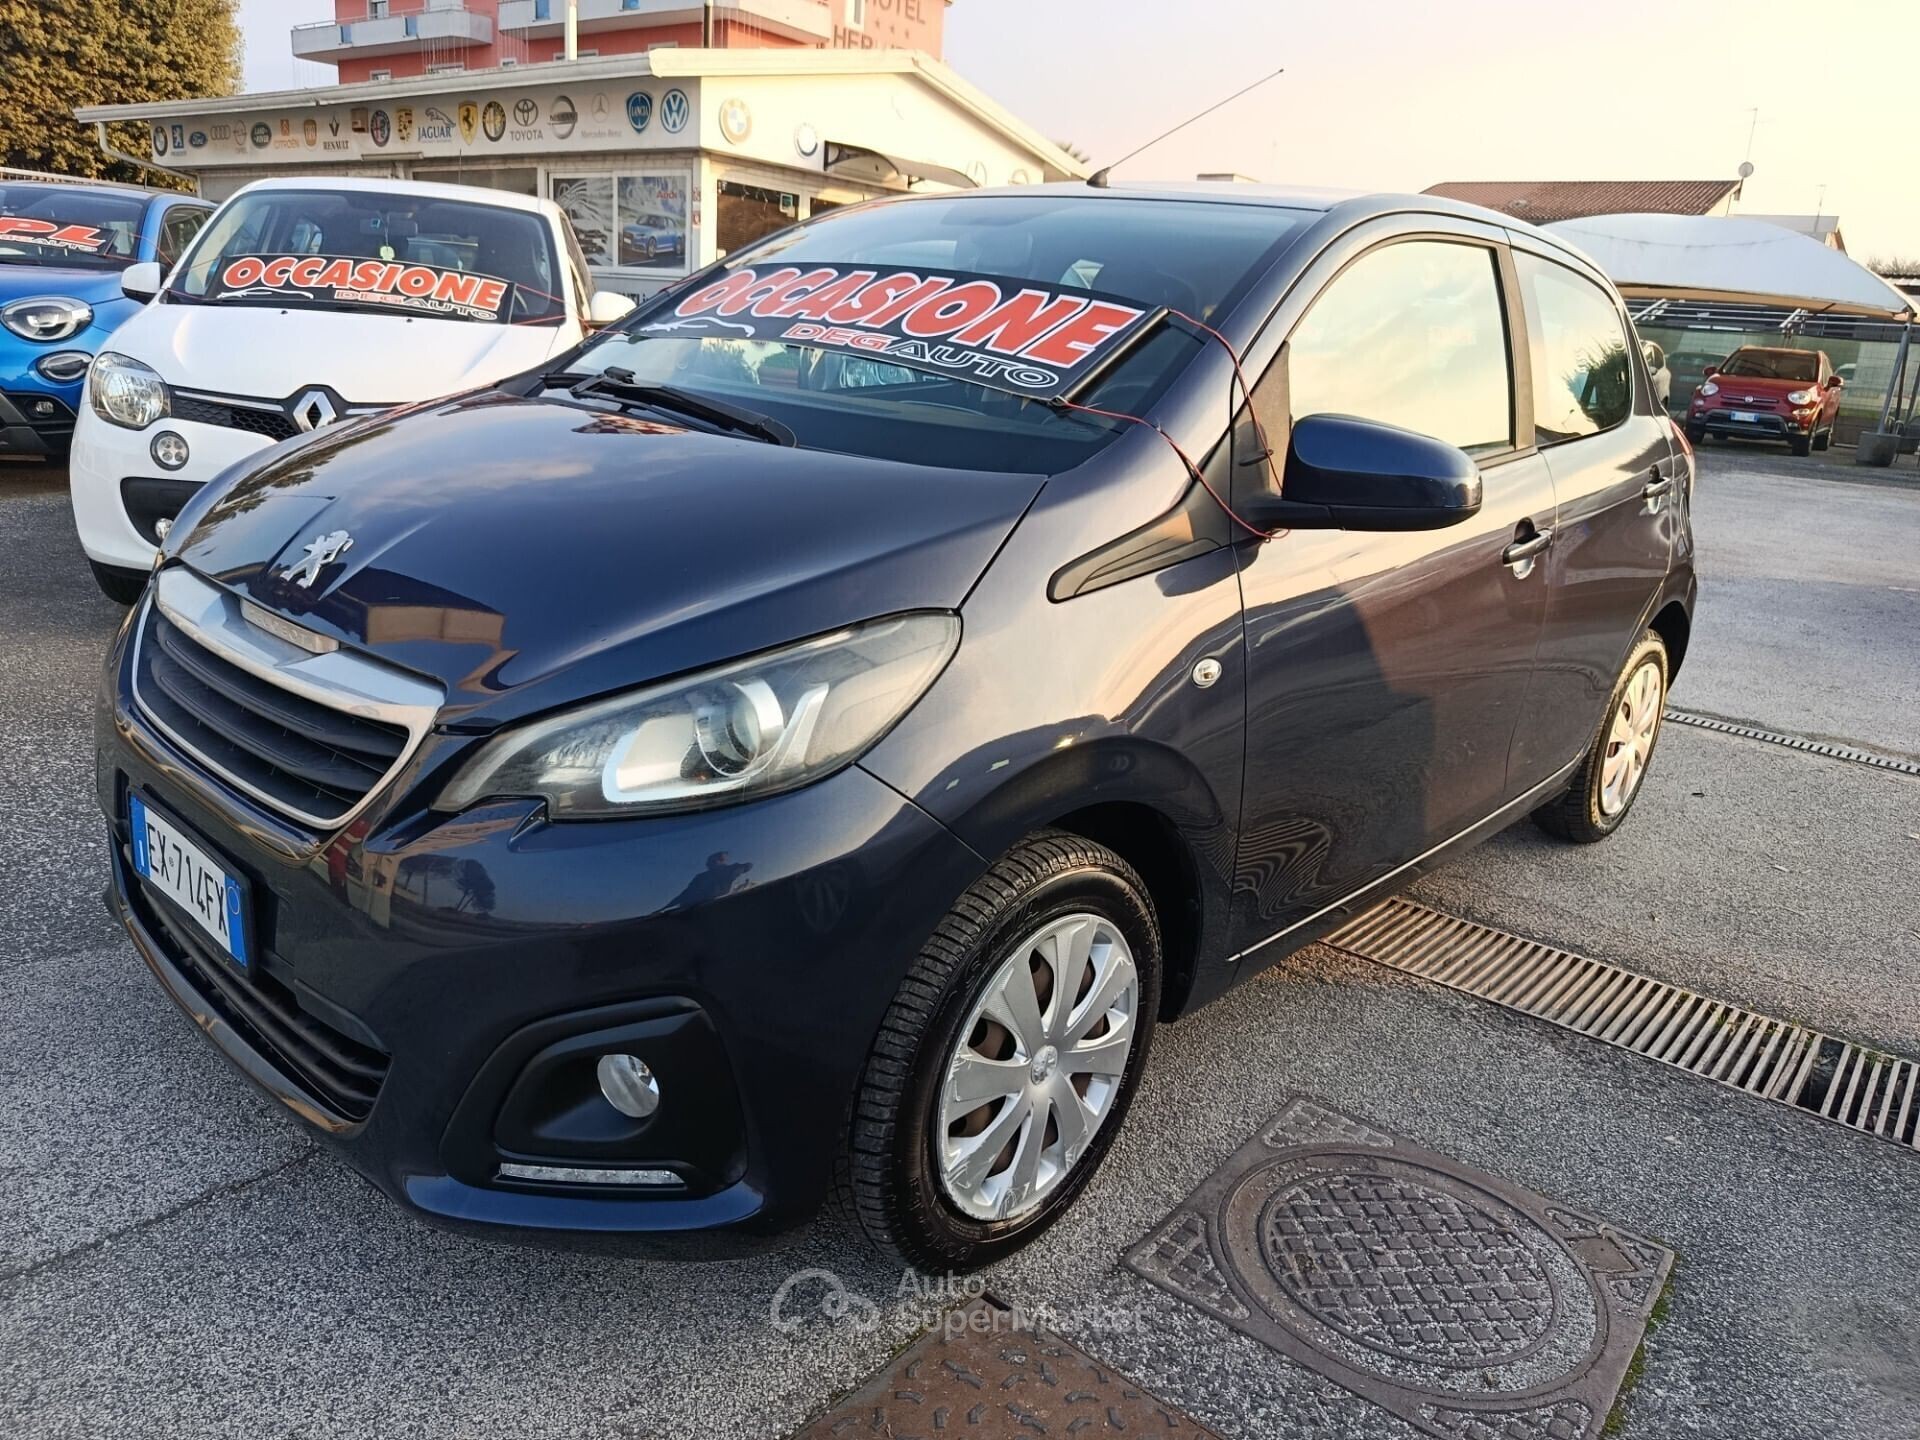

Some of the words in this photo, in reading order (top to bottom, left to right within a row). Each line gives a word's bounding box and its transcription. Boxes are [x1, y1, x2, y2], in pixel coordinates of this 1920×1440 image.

[417, 126, 452, 142] JAGUAR
[510, 130, 543, 142] TOYOTA
[323, 140, 349, 151] RENAULT
[223, 256, 508, 312] OCCASIONE
[674, 267, 1146, 369] OCCASIONE
